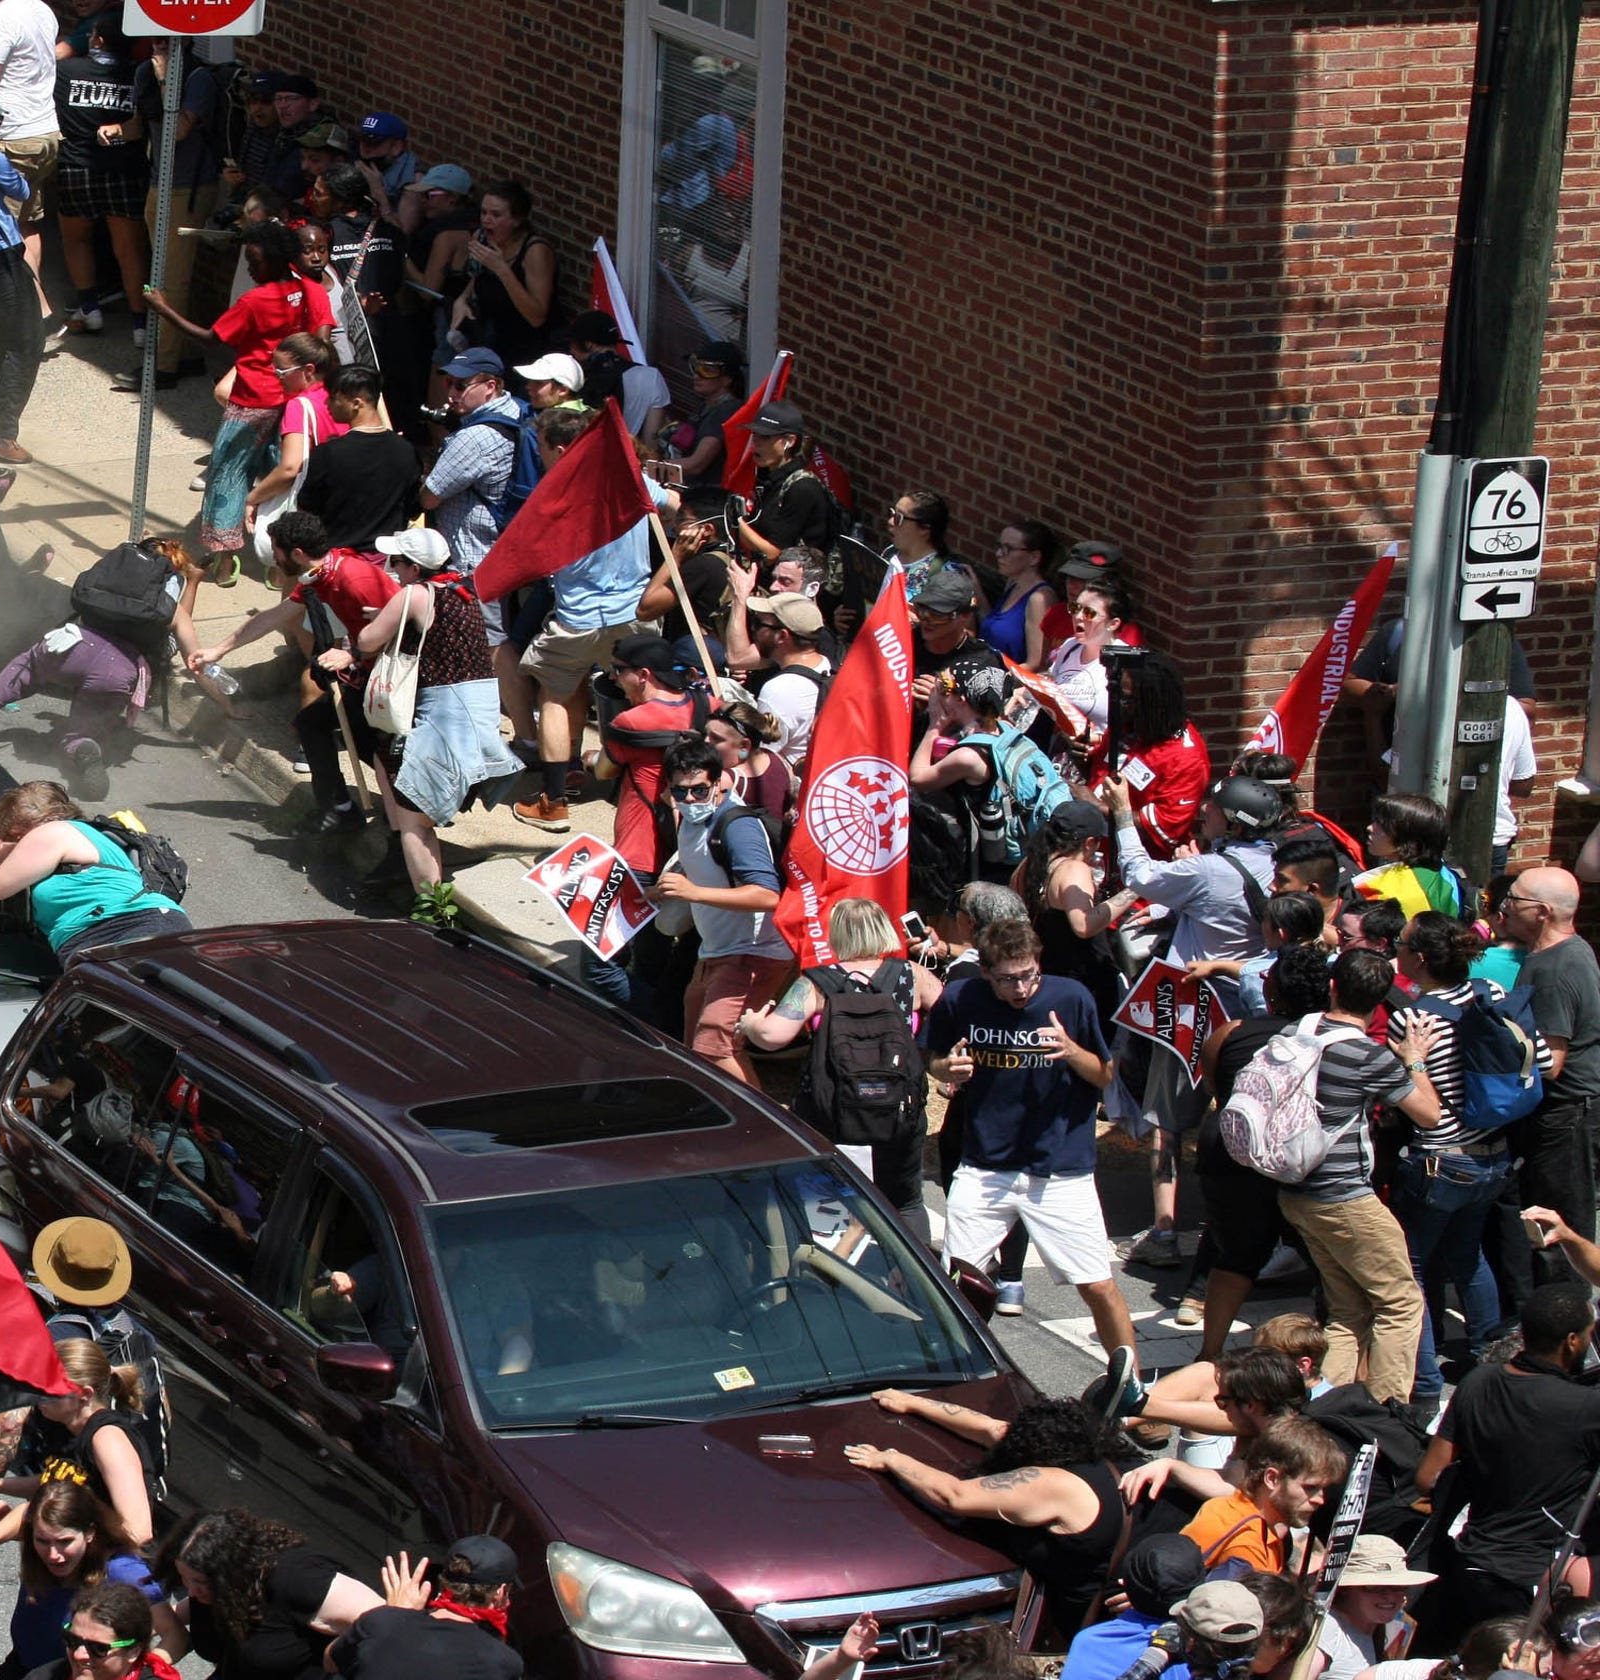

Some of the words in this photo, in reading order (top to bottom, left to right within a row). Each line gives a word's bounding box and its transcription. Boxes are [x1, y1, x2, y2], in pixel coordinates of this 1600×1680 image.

[1487, 488, 1527, 521] 76
[1465, 568, 1519, 579] TransAmrica
[557, 851, 591, 908] ALWAYS
[585, 861, 626, 944] ANTIFASCIST
[807, 921, 824, 938] TO
[811, 941, 833, 963] ALL
[1156, 983, 1174, 1040] ALWAYS
[1188, 987, 1211, 1072] ANTIFASCIST
